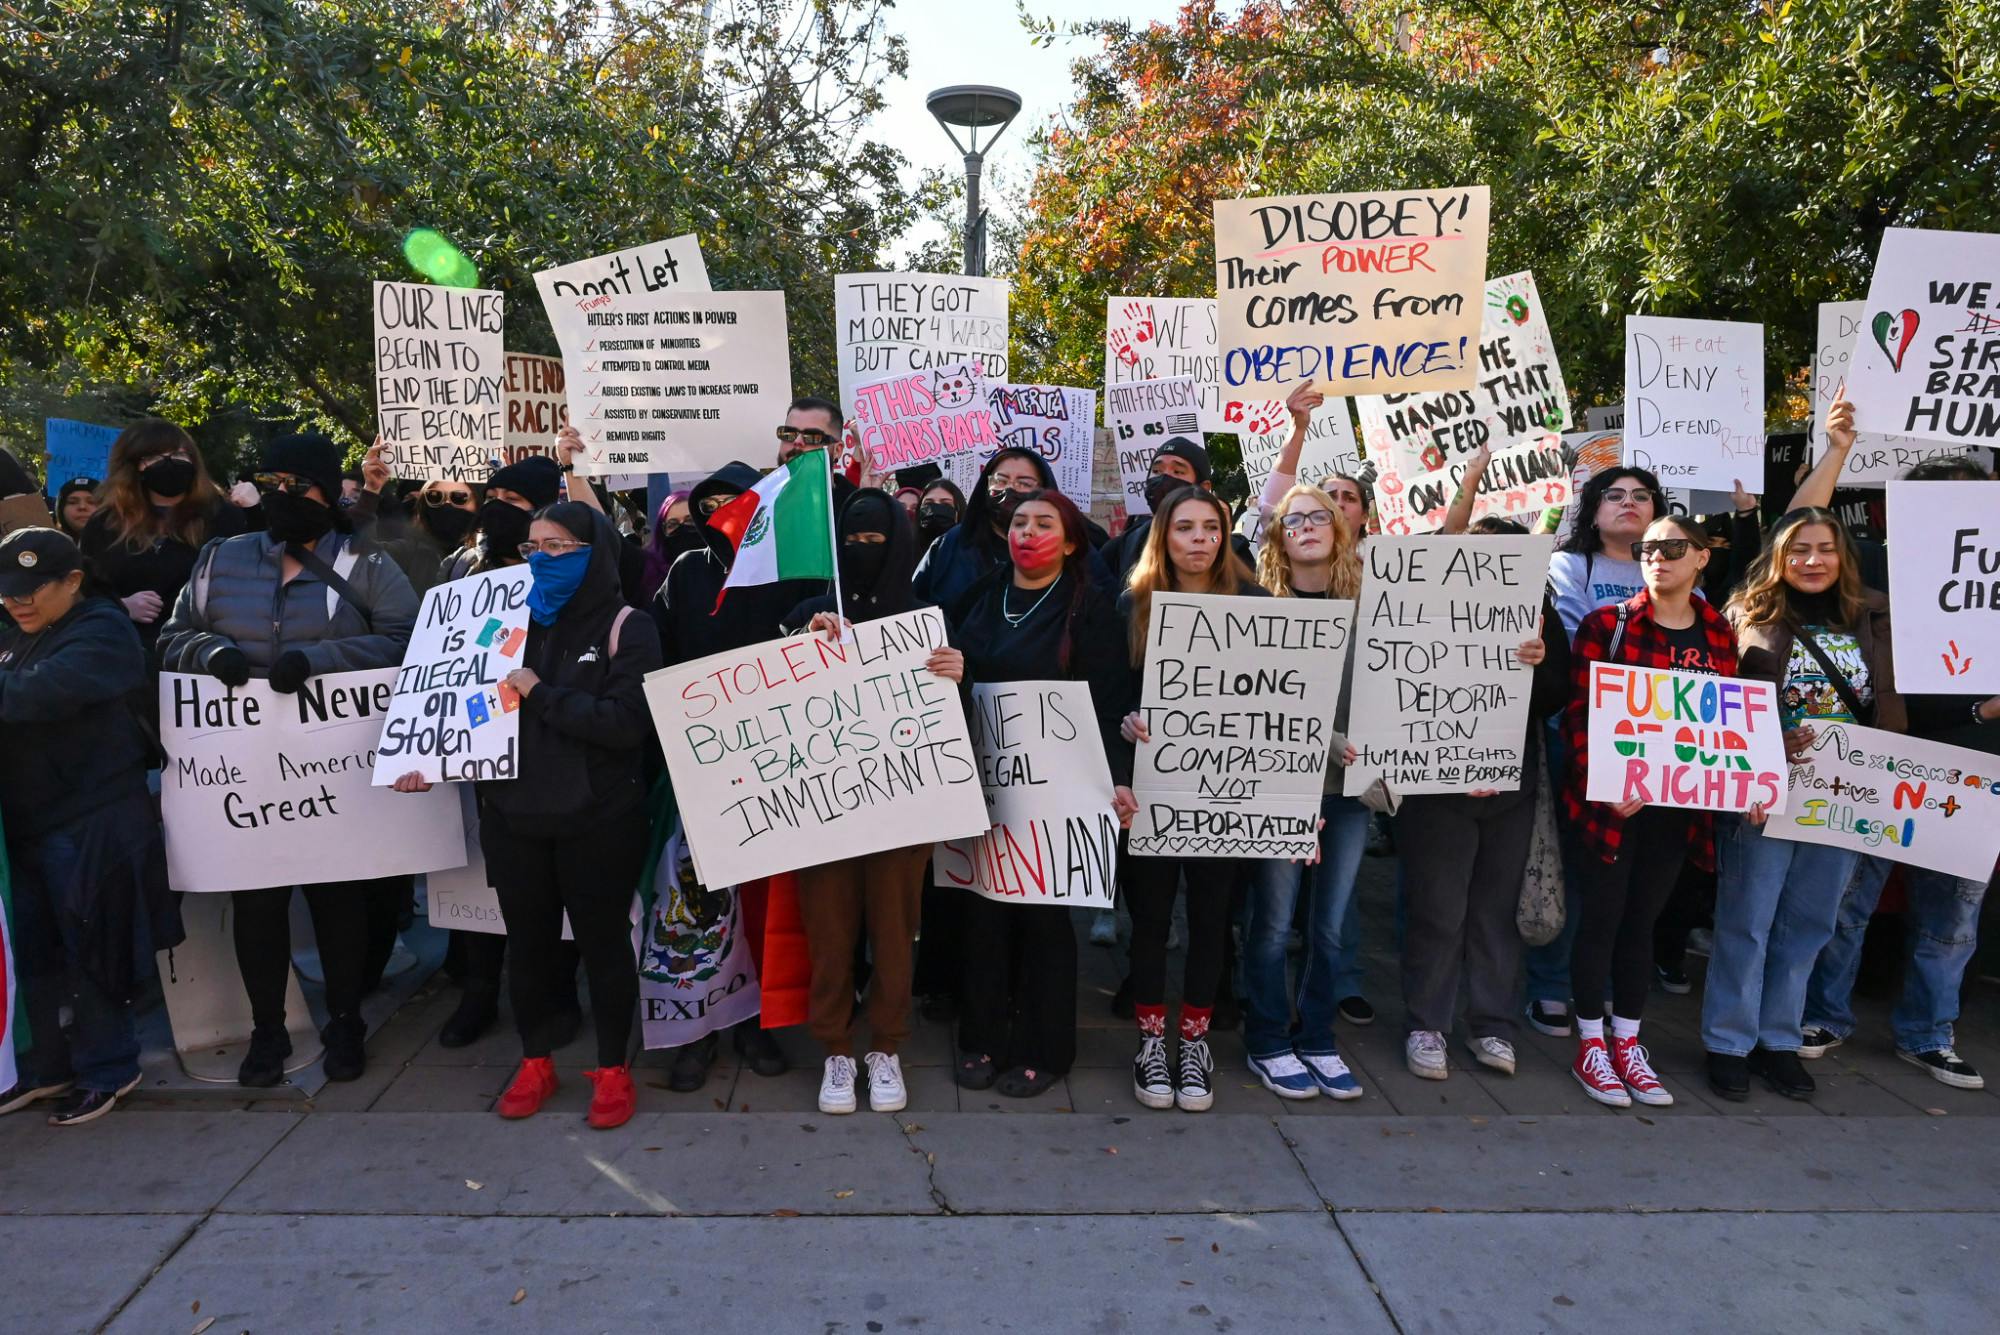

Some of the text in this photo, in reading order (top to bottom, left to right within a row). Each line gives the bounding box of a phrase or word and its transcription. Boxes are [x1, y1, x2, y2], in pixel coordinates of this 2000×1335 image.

[1250, 193, 1470, 250] DISOBEY!
[636, 248, 679, 292] Let
[1218, 242, 1437, 290] Their POWER
[379, 283, 503, 334] OUR LIVES
[848, 283, 980, 312] THEY GOT
[1246, 288, 1464, 329] comes from
[1929, 280, 1992, 309] WE
[587, 311, 738, 326] HITLER'S FIRST ACTIONS IN POWER
[849, 316, 1006, 351] MONEY 4 WARS
[1150, 304, 1194, 350] WE
[378, 336, 480, 372] BEGIN TO
[599, 338, 701, 351] PERSECUTION OF MINORITIES
[854, 346, 899, 373] BUT
[1225, 336, 1469, 387] OBEDIENCE!
[1633, 332, 1718, 393] DENY
[601, 359, 711, 372] ATTEMPTED TO CONTROL MEDIA
[1480, 364, 1551, 406] THAT
[379, 375, 504, 406] END THE DAY
[601, 383, 759, 398] ABUSED EXISTING LAWS TO INCREASE POWER
[856, 374, 937, 426] THIS
[988, 386, 1069, 426] AMERICA
[1109, 380, 1197, 415] ANTI-FASCISM
[380, 409, 502, 441] WE BECOME
[604, 408, 721, 420] ASSISTED BY CONSERVATIVE ELITE
[1117, 419, 1165, 440] is as
[1637, 396, 1721, 438] DEFEND
[384, 443, 449, 465] SILENT
[606, 430, 666, 442] REMOVED RIGHTS
[861, 418, 941, 471] GRABS
[937, 410, 997, 452] BACK
[1431, 418, 1490, 461] FEED
[395, 464, 437, 480] WHAT
[608, 452, 649, 464] FEAR RAIDS
[1849, 448, 1889, 474] OUR
[1408, 478, 1446, 517] ON
[1371, 546, 1522, 587] WE ARE
[427, 576, 525, 629] No One
[1372, 591, 1536, 633] ALL HUMAN
[441, 626, 466, 654] is
[1158, 602, 1347, 653] FAMILIES
[681, 613, 945, 719] STOLEN LAND
[1367, 638, 1522, 674] STOP THE
[1156, 658, 1306, 701] BELONG
[174, 678, 397, 728] Hate Neve
[424, 691, 457, 718] on
[685, 666, 946, 765] BUILT ON THE
[1038, 691, 1077, 741] IS
[378, 717, 472, 757] Stolen
[750, 709, 943, 783] BACKS OF
[1141, 706, 1323, 747] TOGETHER
[1401, 717, 1478, 743] TION
[441, 737, 516, 782] Land
[1153, 742, 1325, 775] COMPASSION
[1355, 744, 1517, 767] HUMAN RIGHTS
[1674, 726, 1752, 772] OUR
[178, 755, 247, 788] Made
[1198, 774, 1262, 798] NOT
[1382, 764, 1523, 784] HAVE NO BORDERS
[1622, 758, 1780, 810] RIGHTS
[1788, 764, 1961, 818] Native Not
[224, 784, 340, 829] Great
[720, 737, 975, 847] IMMIGRANTS
[1150, 803, 1317, 839] DEPORTATION
[1042, 813, 1119, 901] LAND
